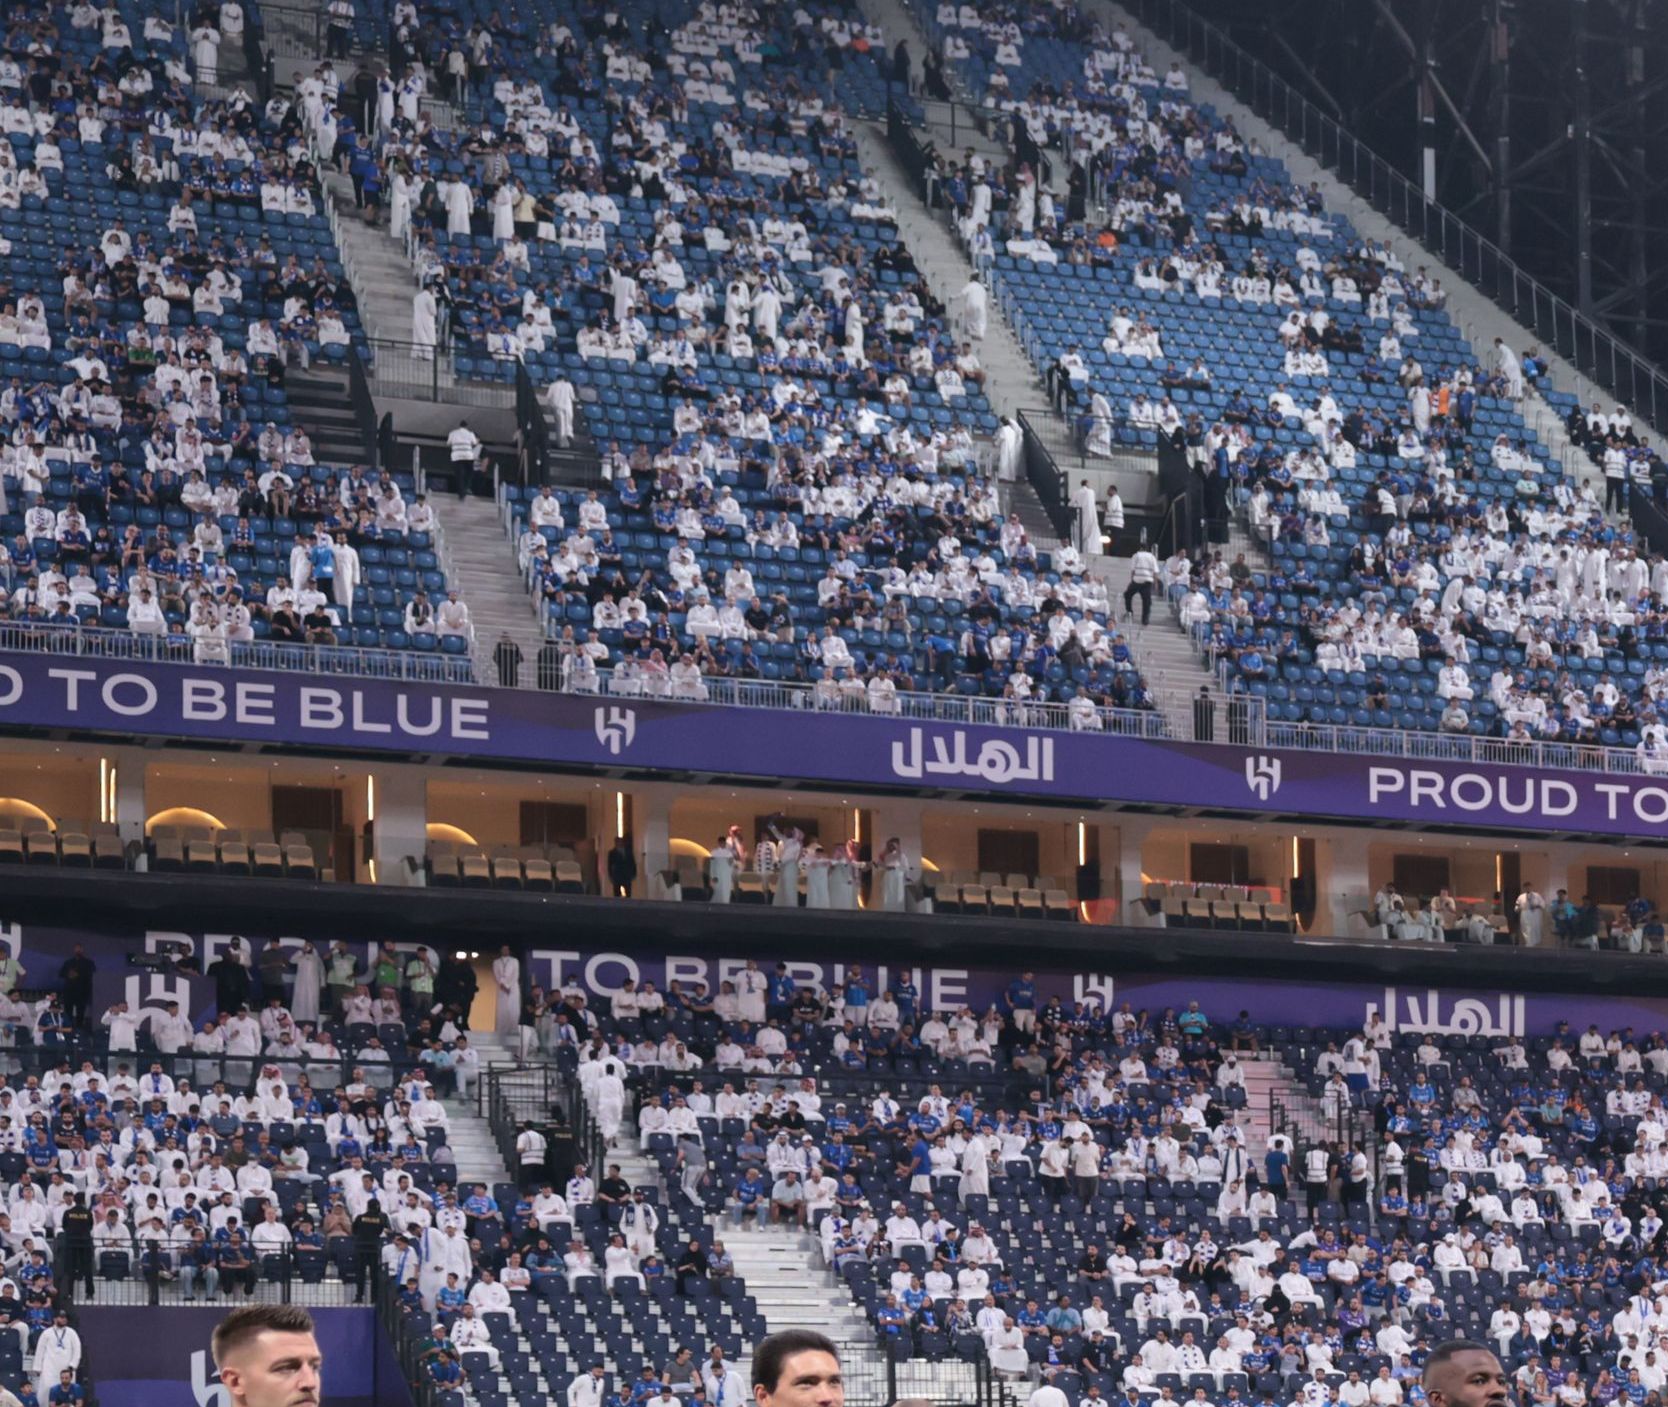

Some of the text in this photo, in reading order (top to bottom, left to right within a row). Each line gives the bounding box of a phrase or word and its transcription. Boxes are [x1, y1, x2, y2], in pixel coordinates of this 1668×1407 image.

[48, 668, 158, 716] TO
[182, 678, 276, 725] BE
[300, 687, 490, 740] BLUE
[892, 727, 1054, 783] الهلال
[1368, 767, 1578, 816] PROUD
[532, 950, 641, 998] TO
